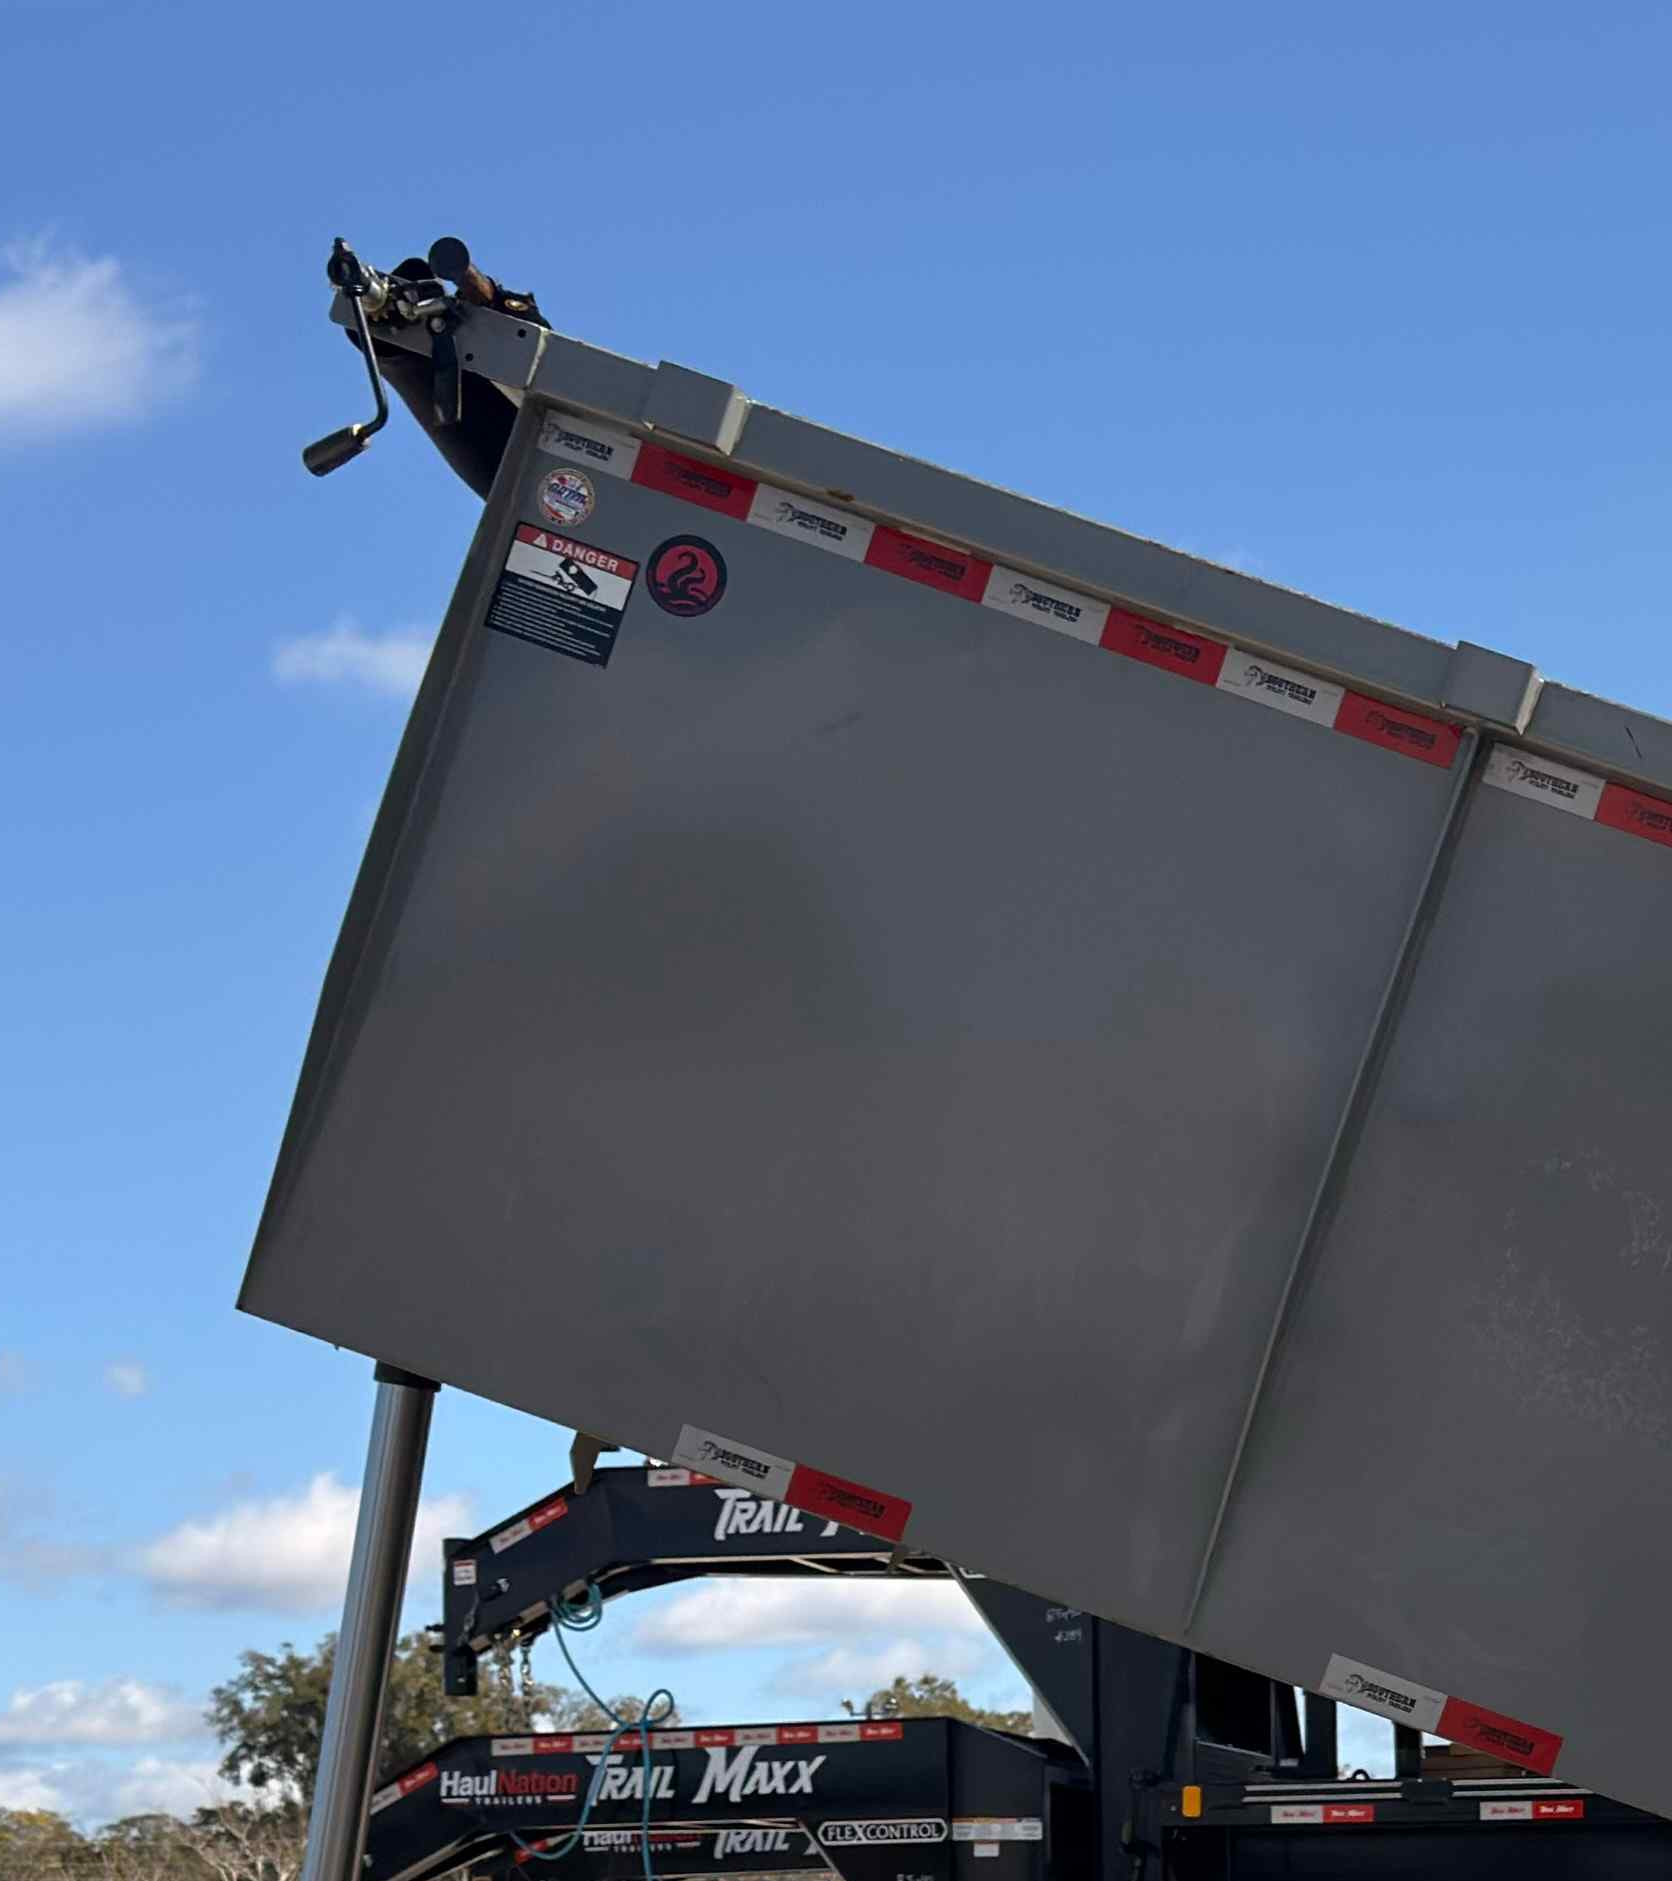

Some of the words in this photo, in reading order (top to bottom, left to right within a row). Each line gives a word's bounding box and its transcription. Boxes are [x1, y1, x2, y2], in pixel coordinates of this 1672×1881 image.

[552, 539, 619, 572] DANGER
[713, 1488, 804, 1541] TRAIL
[440, 1769, 578, 1797] HaulNation
[585, 1754, 676, 1807] TRAIL
[691, 1745, 827, 1803] MAXX
